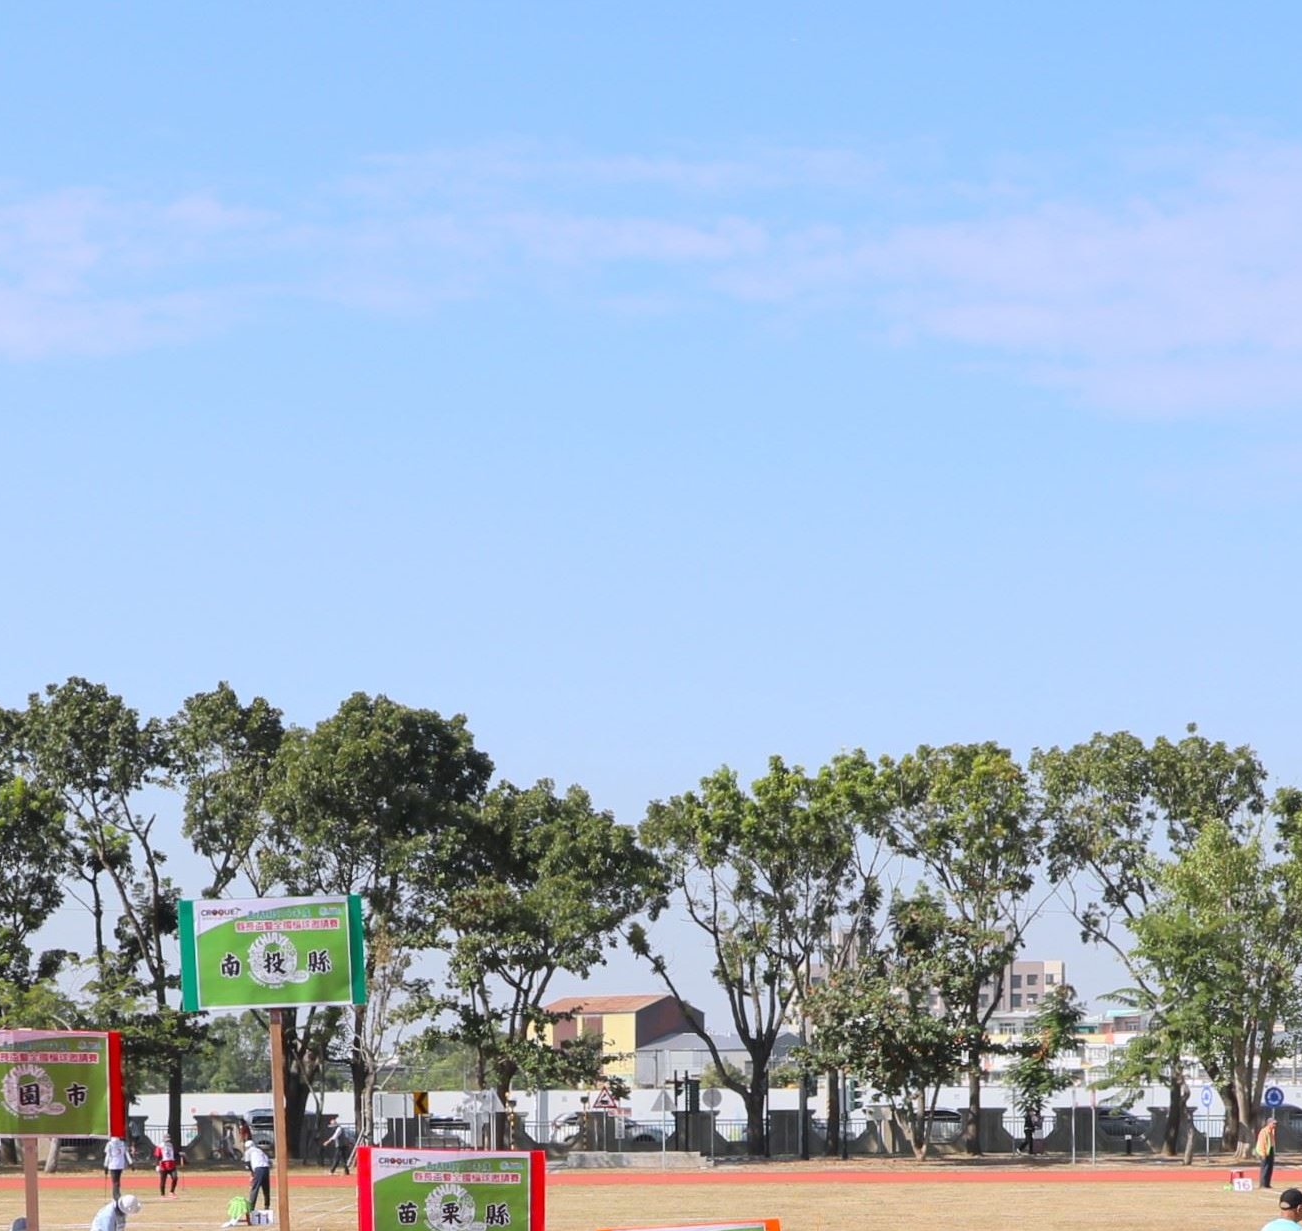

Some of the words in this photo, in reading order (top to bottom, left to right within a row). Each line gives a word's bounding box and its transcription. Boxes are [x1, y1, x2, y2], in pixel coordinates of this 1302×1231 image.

[201, 907, 241, 917] CROQUET
[220, 949, 332, 978] 南投縣
[379, 1157, 421, 1165] CROQUET
[397, 1201, 511, 1226] 苗栗縣
